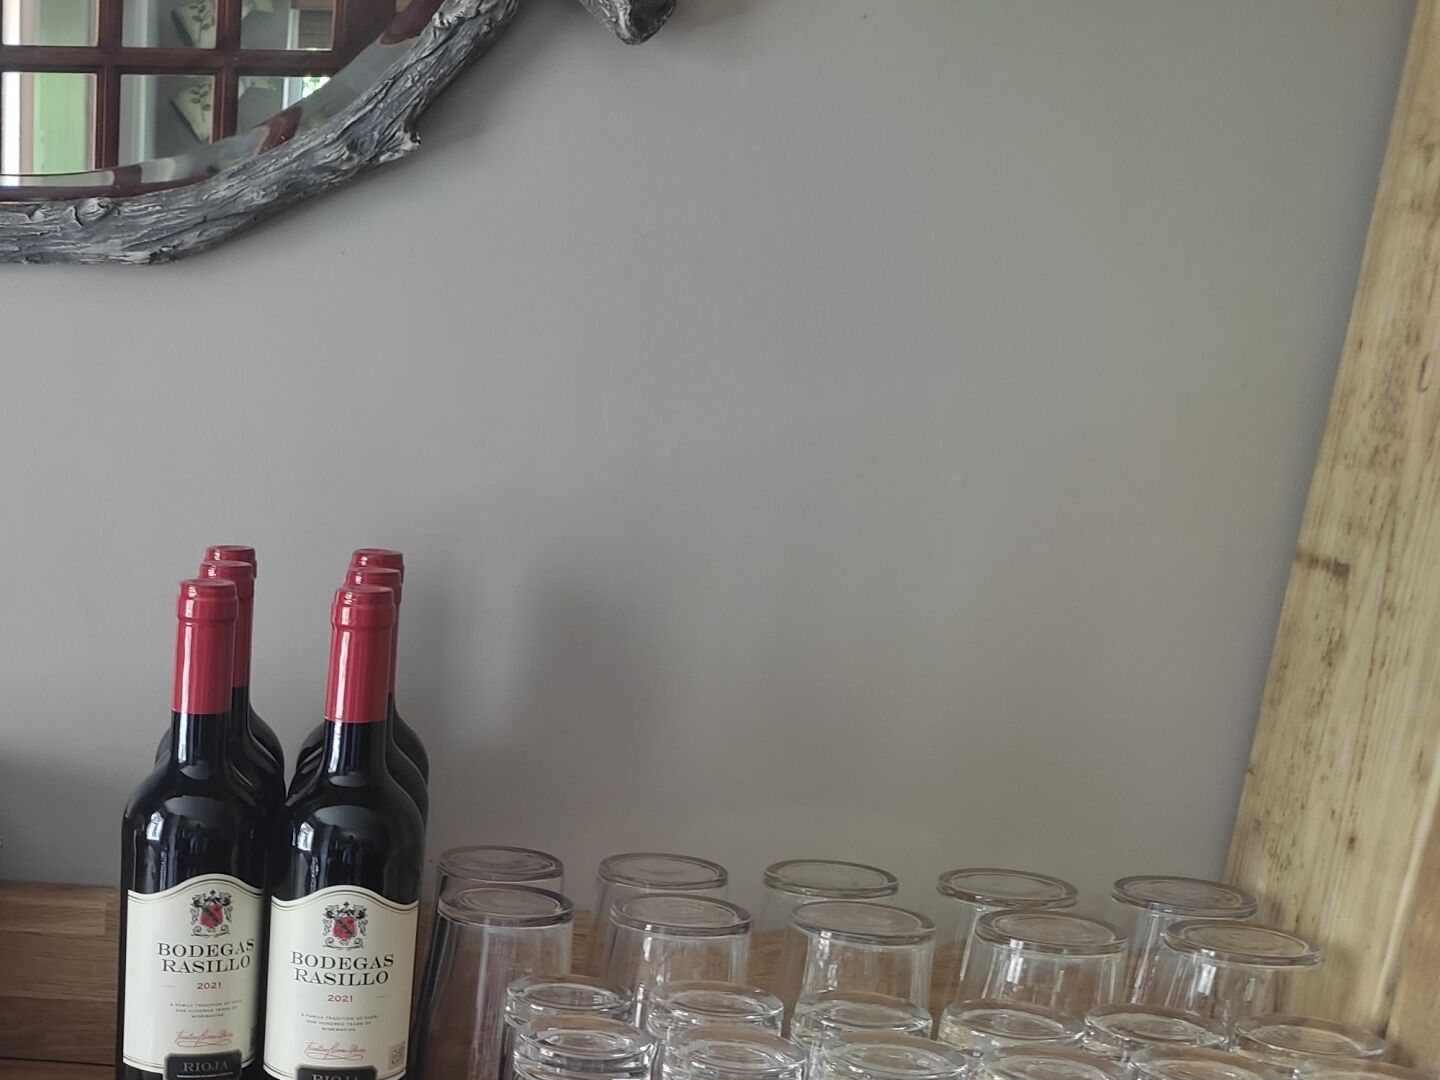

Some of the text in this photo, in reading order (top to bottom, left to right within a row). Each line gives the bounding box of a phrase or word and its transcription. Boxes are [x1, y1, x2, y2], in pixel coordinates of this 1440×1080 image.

[157, 938, 255, 958] BODEGAS
[161, 955, 251, 974] RASILLO
[290, 950, 394, 970] BODEGAS
[196, 981, 222, 991] 2021
[293, 968, 389, 986] RASILLO
[327, 994, 354, 1003] 2021
[182, 1059, 230, 1073] RIOJA
